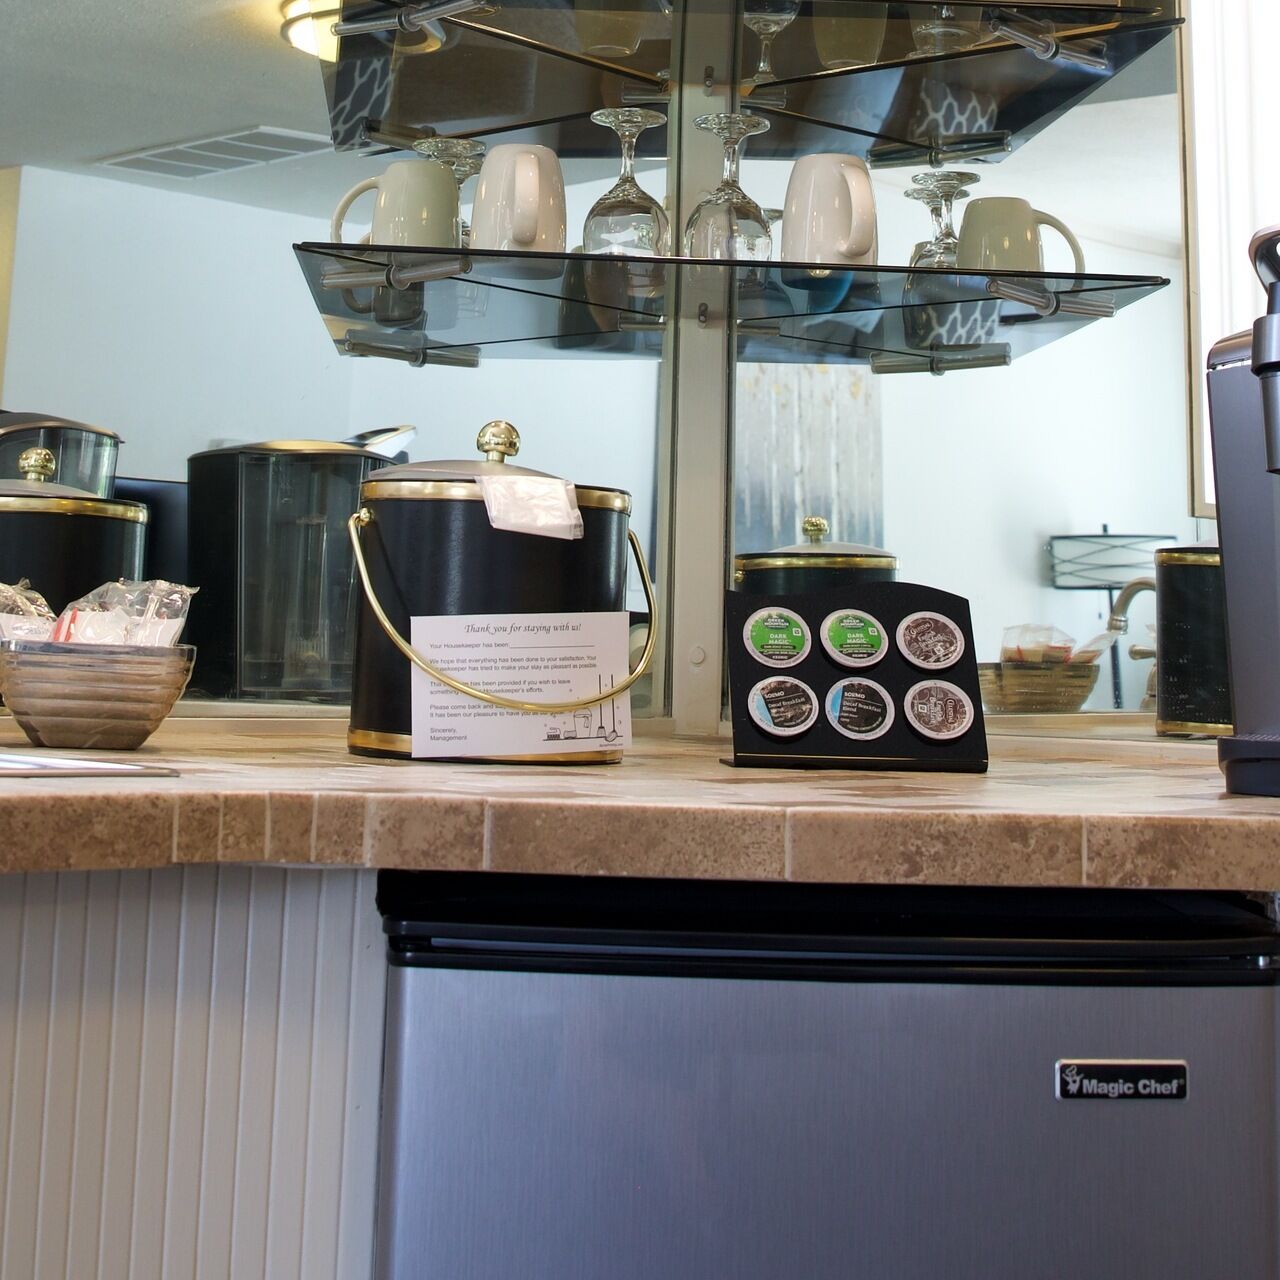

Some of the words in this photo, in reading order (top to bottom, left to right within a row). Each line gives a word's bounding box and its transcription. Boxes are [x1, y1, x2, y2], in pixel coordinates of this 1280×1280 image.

[464, 623, 492, 634] Thank
[493, 626, 507, 635] you
[507, 622, 522, 635] for
[523, 624, 551, 634] staying
[553, 622, 570, 632] with
[1082, 1078, 1134, 1098] Magic
[1138, 1079, 1179, 1095] Chef
